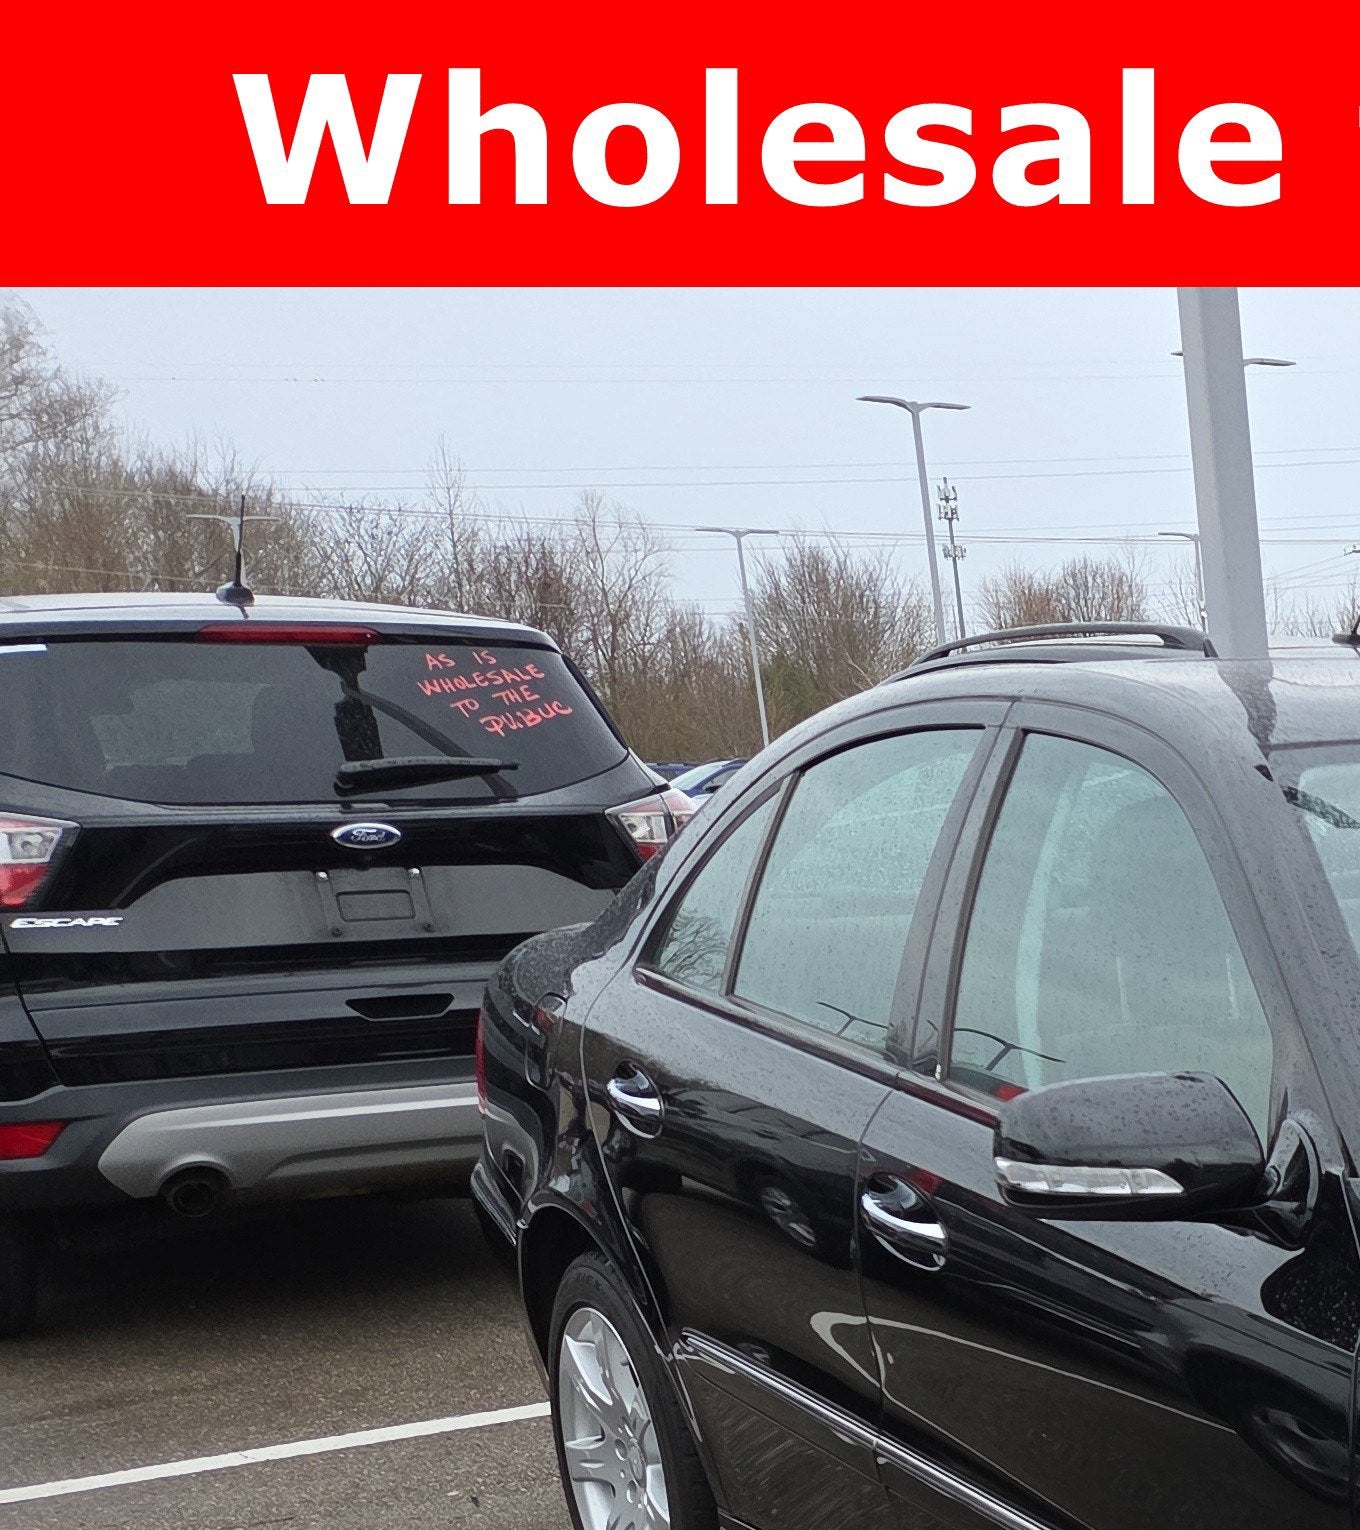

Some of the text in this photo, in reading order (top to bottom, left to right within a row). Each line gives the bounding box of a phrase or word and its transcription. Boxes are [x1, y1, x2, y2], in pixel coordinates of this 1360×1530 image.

[425, 649, 498, 671] AS IS
[417, 663, 546, 696] WHOLESALE
[449, 684, 540, 718] TO THE
[350, 828, 387, 842] Ford
[9, 917, 125, 929] ESCAPE
